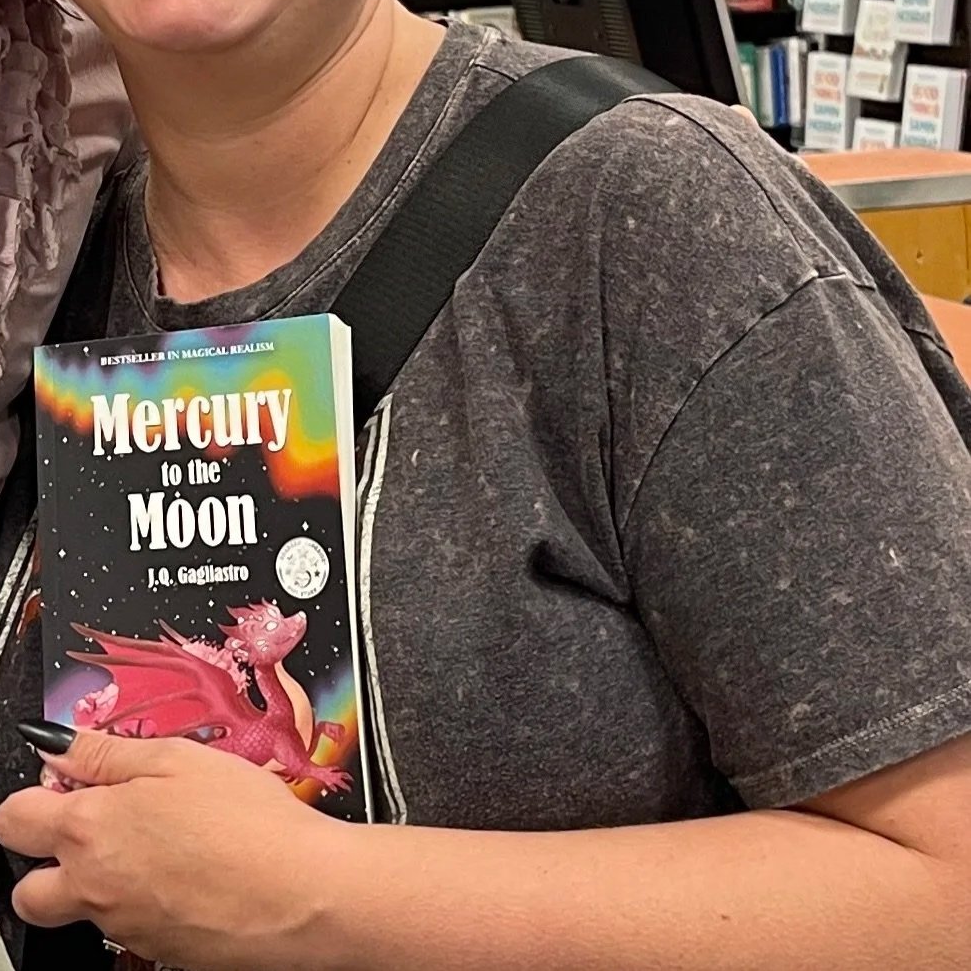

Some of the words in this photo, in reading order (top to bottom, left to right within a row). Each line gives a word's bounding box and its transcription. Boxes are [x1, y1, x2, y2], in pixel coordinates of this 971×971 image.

[100, 351, 165, 366] BESTSELLER
[167, 350, 179, 360] IN
[181, 346, 230, 359] MAGICAL
[230, 341, 275, 355] REALISM
[90, 388, 292, 456] Mercury
[161, 461, 182, 487] to
[187, 458, 221, 485] the
[128, 491, 258, 552] Moon
[147, 566, 174, 589] J.Q.
[177, 564, 249, 586] Gagliastro
